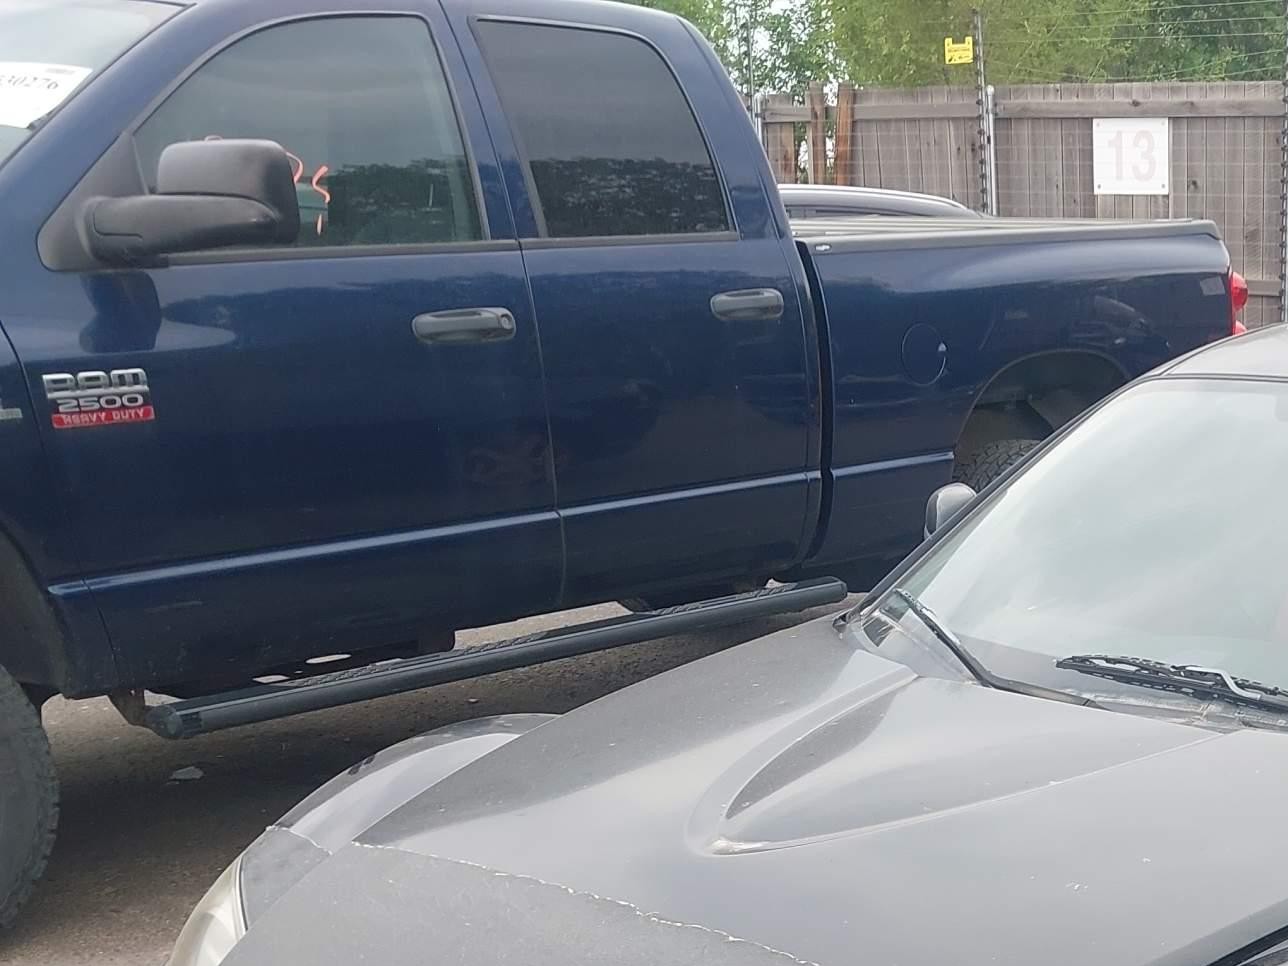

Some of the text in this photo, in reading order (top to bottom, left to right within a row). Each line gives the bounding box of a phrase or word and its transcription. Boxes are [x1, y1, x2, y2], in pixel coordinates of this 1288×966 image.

[1107, 129, 1156, 181] 13
[42, 368, 149, 399] RAM
[57, 393, 144, 412] 2500
[62, 408, 145, 425] HEAVY DUTY
